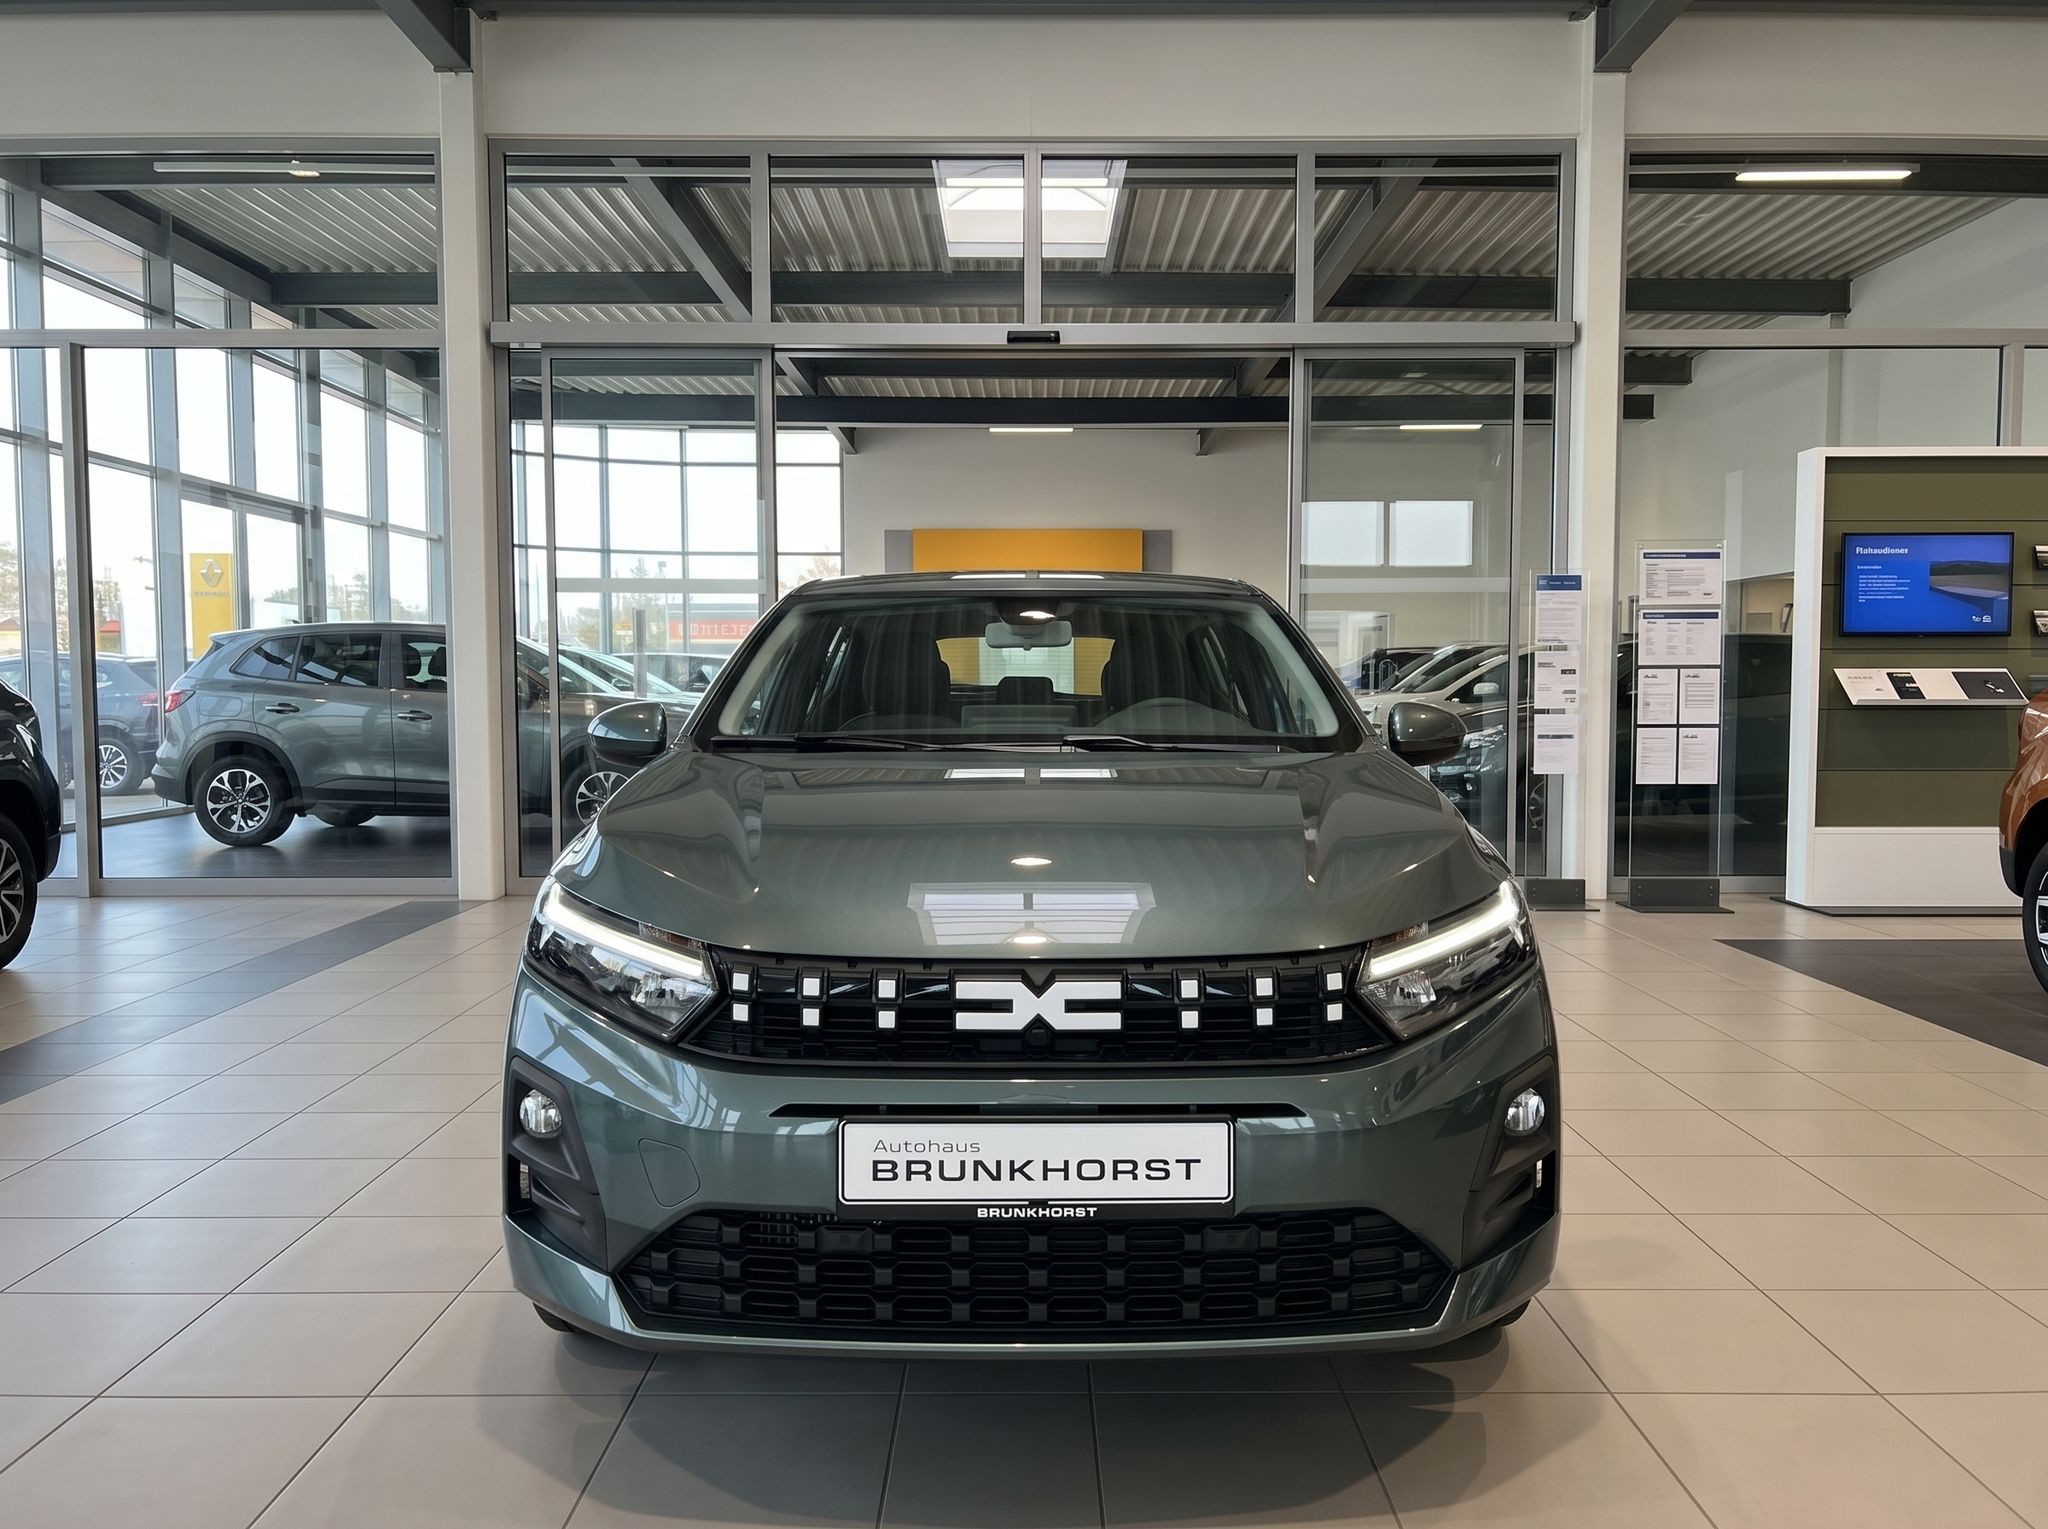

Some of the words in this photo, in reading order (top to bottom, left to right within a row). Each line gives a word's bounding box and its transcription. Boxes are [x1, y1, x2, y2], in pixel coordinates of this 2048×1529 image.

[873, 1139, 981, 1153] Autohaus
[872, 1158, 1202, 1182] BRUNKHORST
[977, 1207, 1098, 1218] BRUNKHORST
